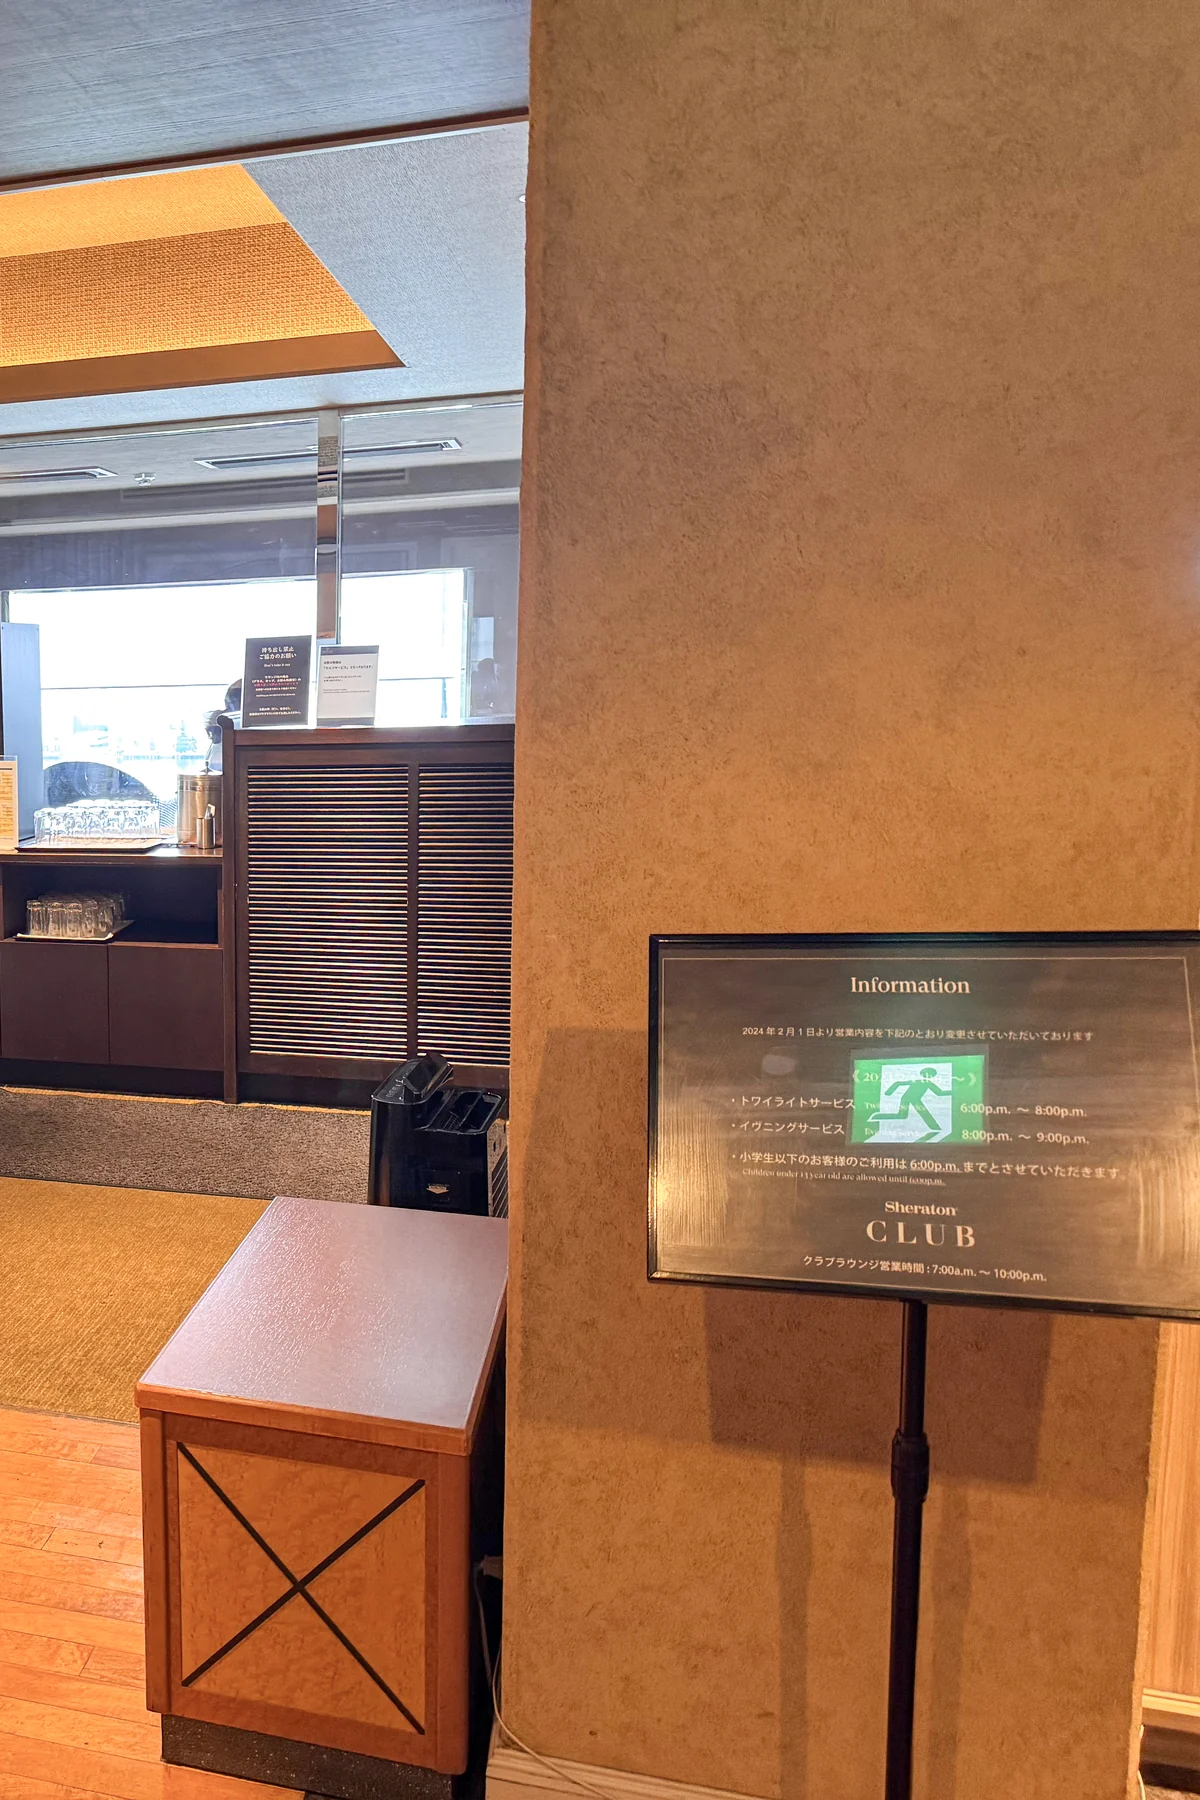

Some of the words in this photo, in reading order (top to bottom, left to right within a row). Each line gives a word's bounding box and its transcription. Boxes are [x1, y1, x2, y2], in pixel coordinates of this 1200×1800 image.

[851, 976, 970, 994] Information
[960, 1103, 1011, 1116] 6:00p.m.
[1035, 1105, 1088, 1118] 8:00p.m.
[962, 1130, 1013, 1142] 8:00p.m.
[1036, 1132, 1090, 1145] 9:00p.m.
[910, 1159, 960, 1172] 6:00p.m.
[742, 1168, 774, 1176] Children
[776, 1170, 798, 1178] under
[810, 1172, 826, 1180] year
[828, 1172, 840, 1180] old
[856, 1174, 887, 1182] allowed
[884, 1201, 956, 1216] Sheraton
[866, 1220, 976, 1248] CLUB
[994, 1268, 1047, 1282] 10:00p.m.
